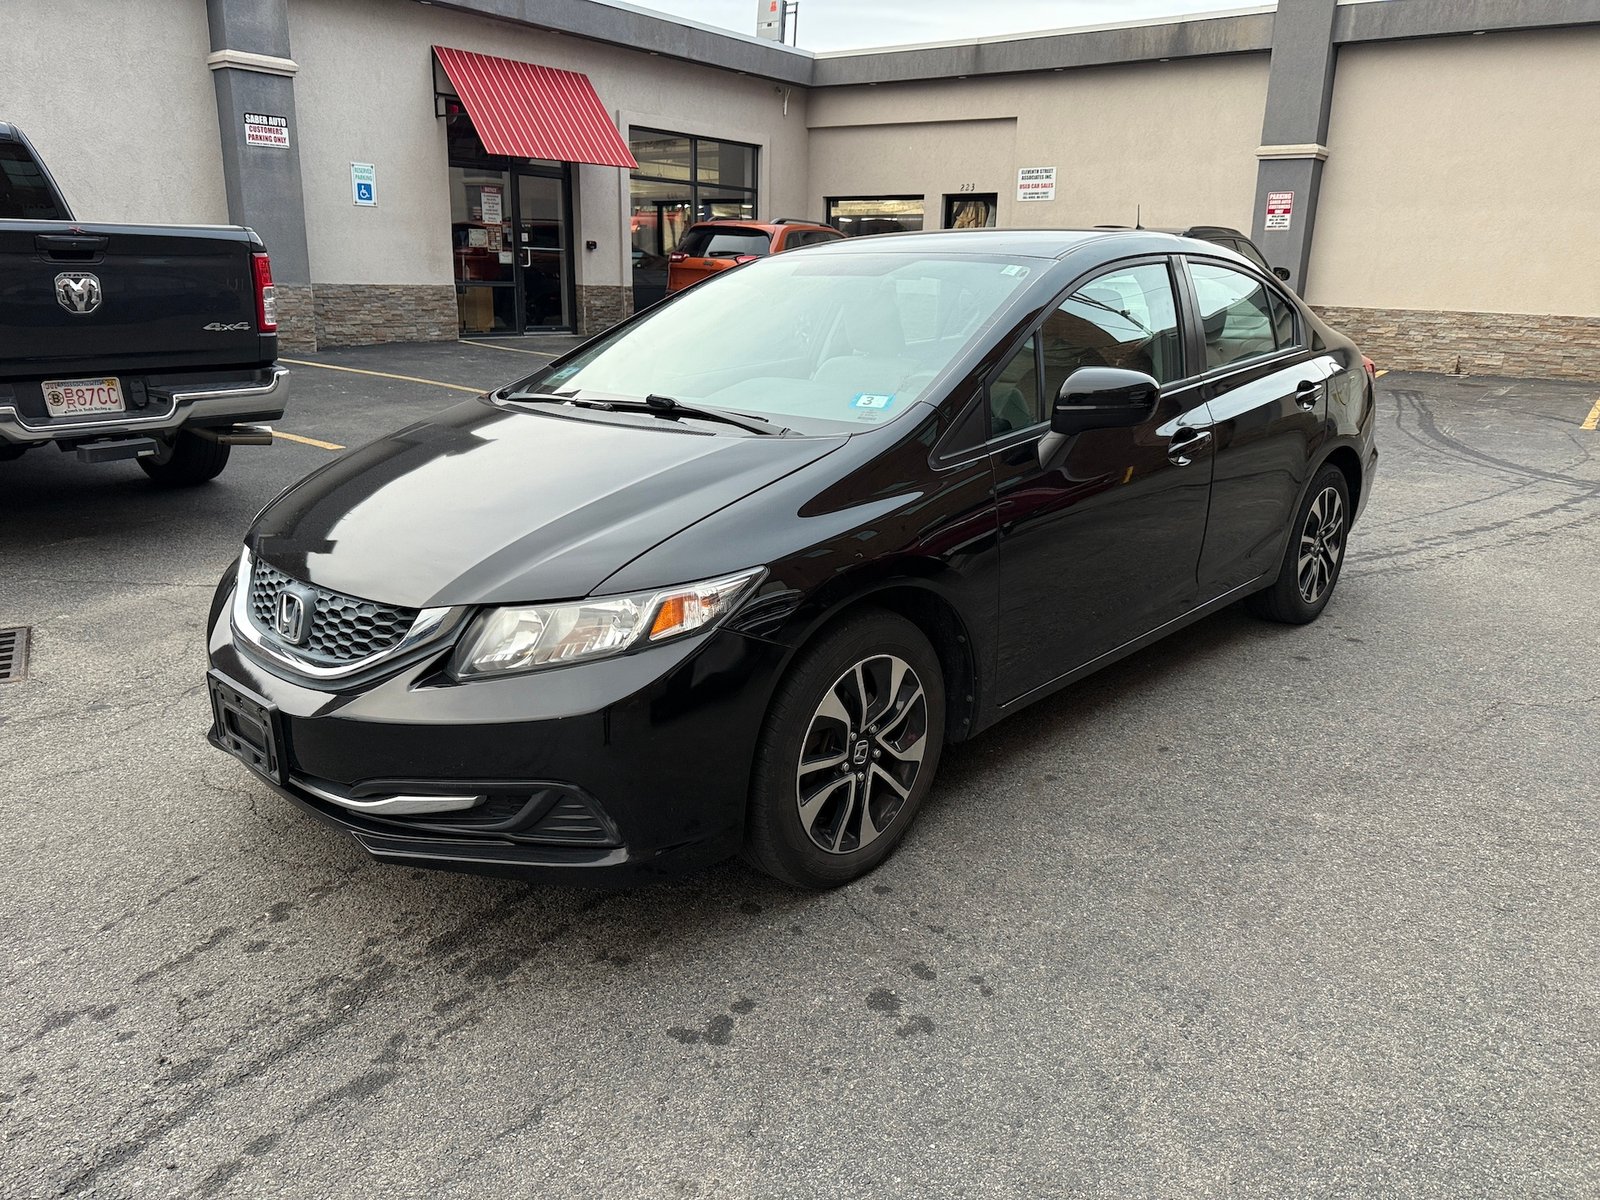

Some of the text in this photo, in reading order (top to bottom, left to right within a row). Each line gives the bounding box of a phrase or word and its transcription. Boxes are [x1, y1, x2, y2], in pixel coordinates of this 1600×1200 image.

[245, 114, 286, 127] SABER AUTO
[248, 126, 283, 135] CUSTOMERS
[248, 133, 273, 142] PARKING
[960, 183, 975, 191] 223
[862, 396, 875, 405] 3
